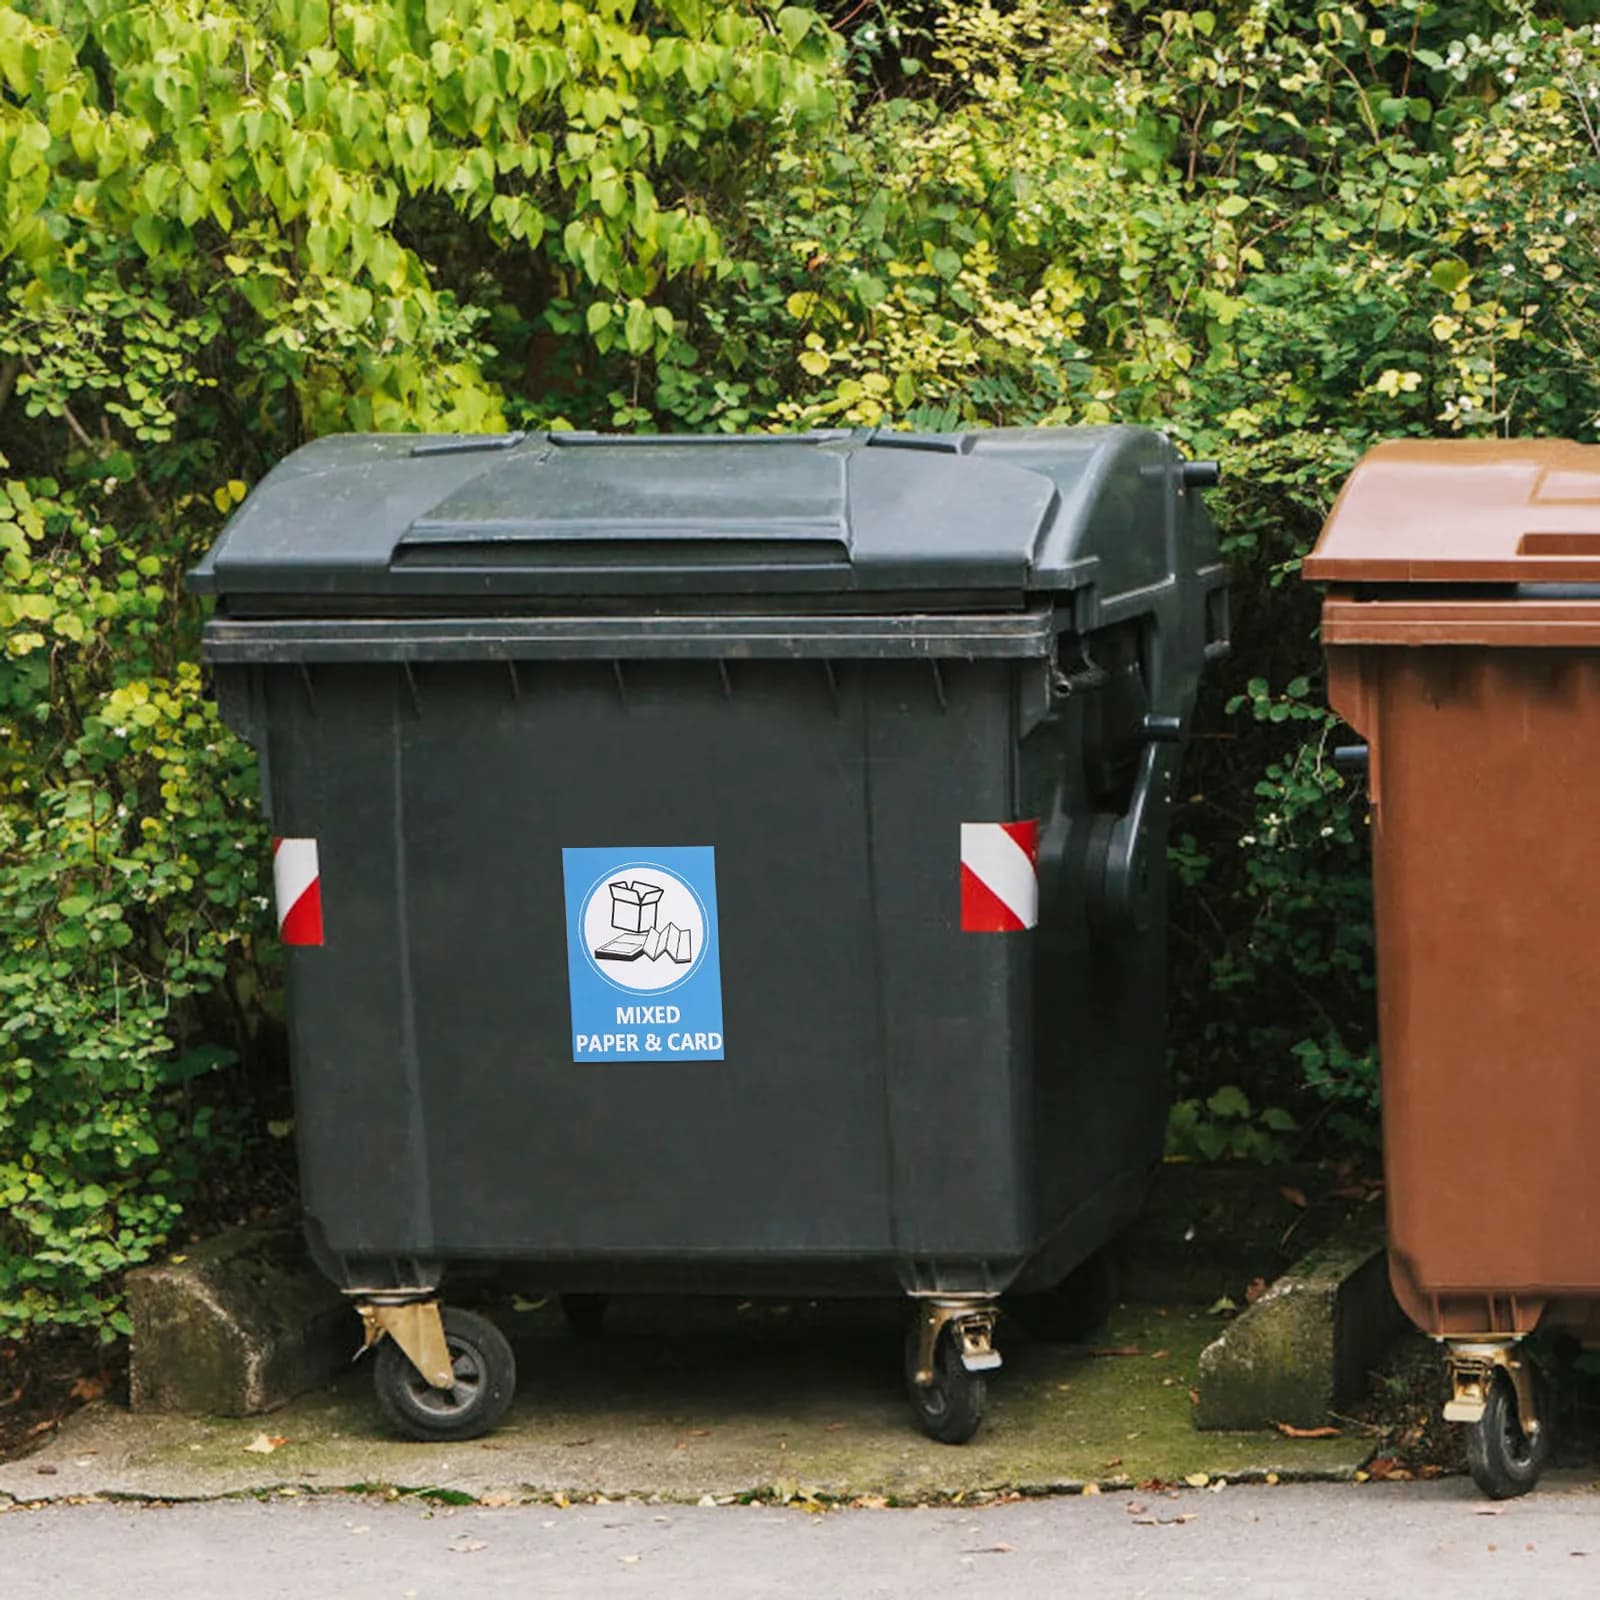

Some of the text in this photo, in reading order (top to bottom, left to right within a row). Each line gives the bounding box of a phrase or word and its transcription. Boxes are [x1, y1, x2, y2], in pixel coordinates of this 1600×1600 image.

[616, 1006, 681, 1024] MIXED
[576, 1032, 722, 1052] PAPER & CARD
